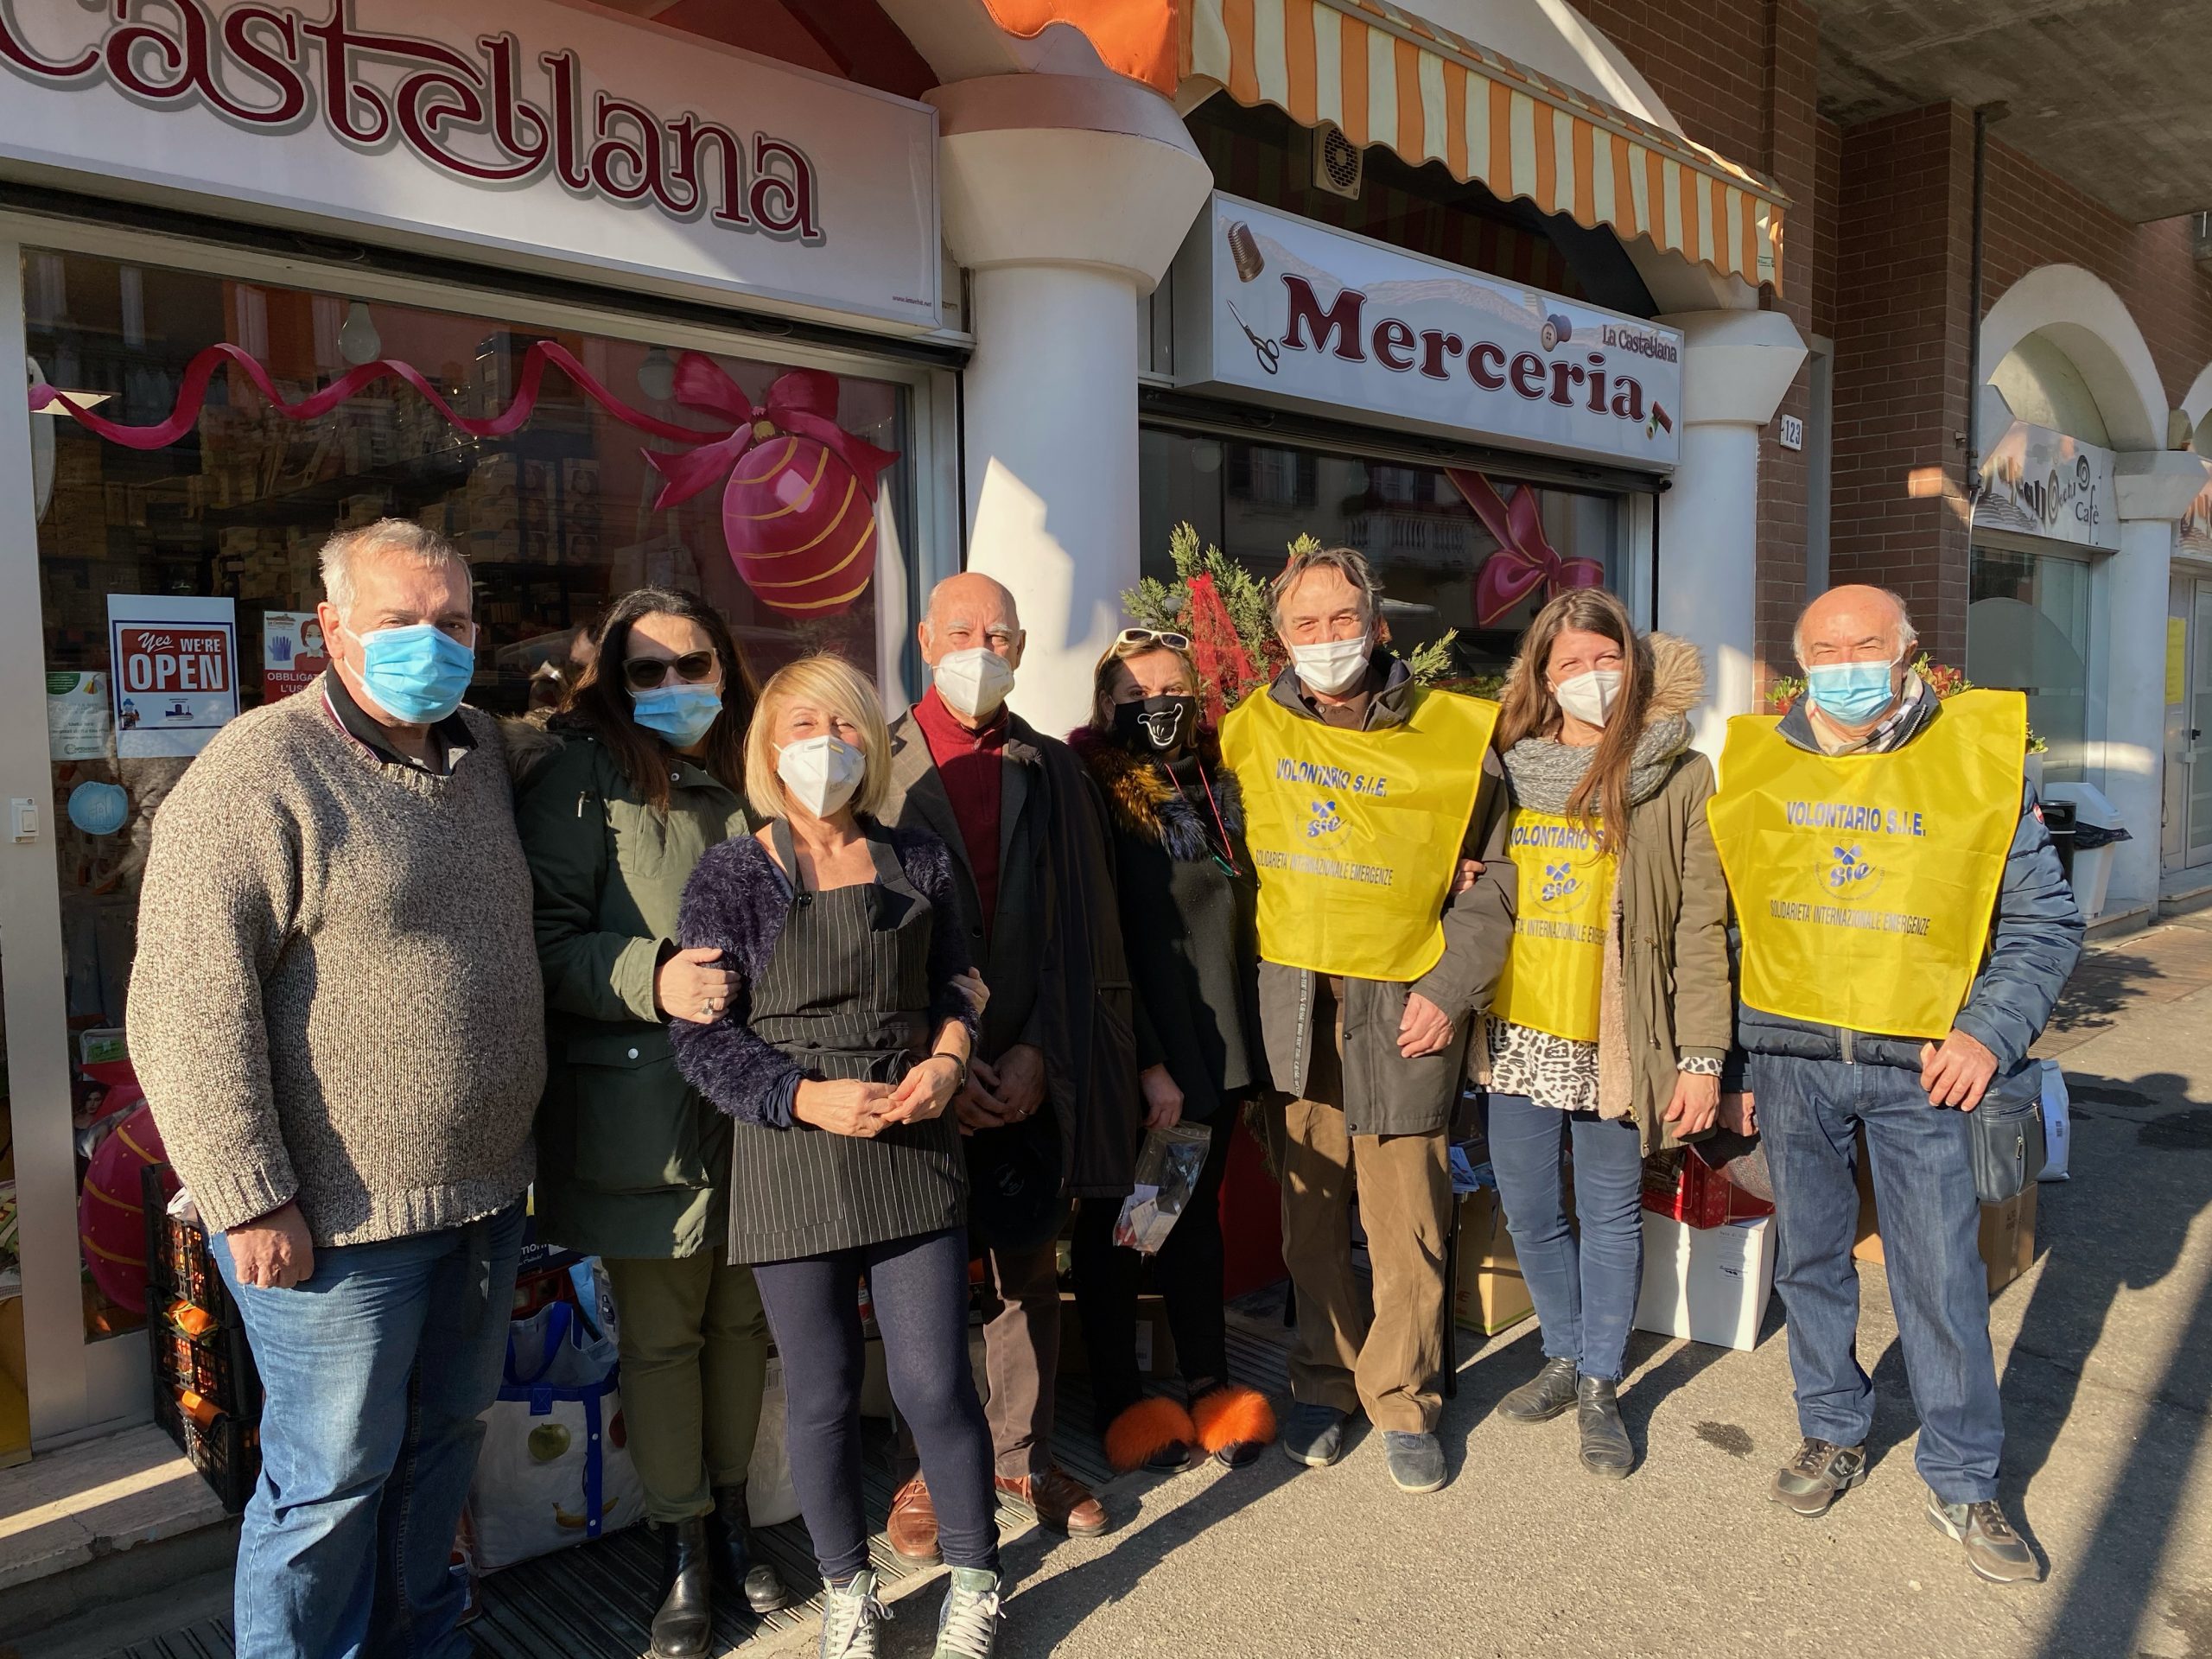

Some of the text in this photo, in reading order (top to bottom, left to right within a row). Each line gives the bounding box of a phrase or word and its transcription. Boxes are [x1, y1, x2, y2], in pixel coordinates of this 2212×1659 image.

[1281, 272, 1646, 423] Merceria
[1603, 325, 1677, 363] La Castellana
[1786, 420, 1801, 444] 123
[138, 632, 221, 653] Yes WE'RE
[128, 652, 224, 691] OPEN
[1276, 758, 1388, 798] VOLONTARIO S.I.E.
[1787, 801, 1926, 836] VOLONTARIO S.I.E.
[1510, 825, 1590, 851] VOLONTARIO
[1290, 851, 1349, 880] INTERNAZIONALE
[1350, 864, 1394, 887] EMERGENZE
[1527, 918, 1586, 941] INTERNAZIONALE
[1770, 899, 1930, 936] SOLIDARIETA' INTERNAZIONALE EMERGENZE
